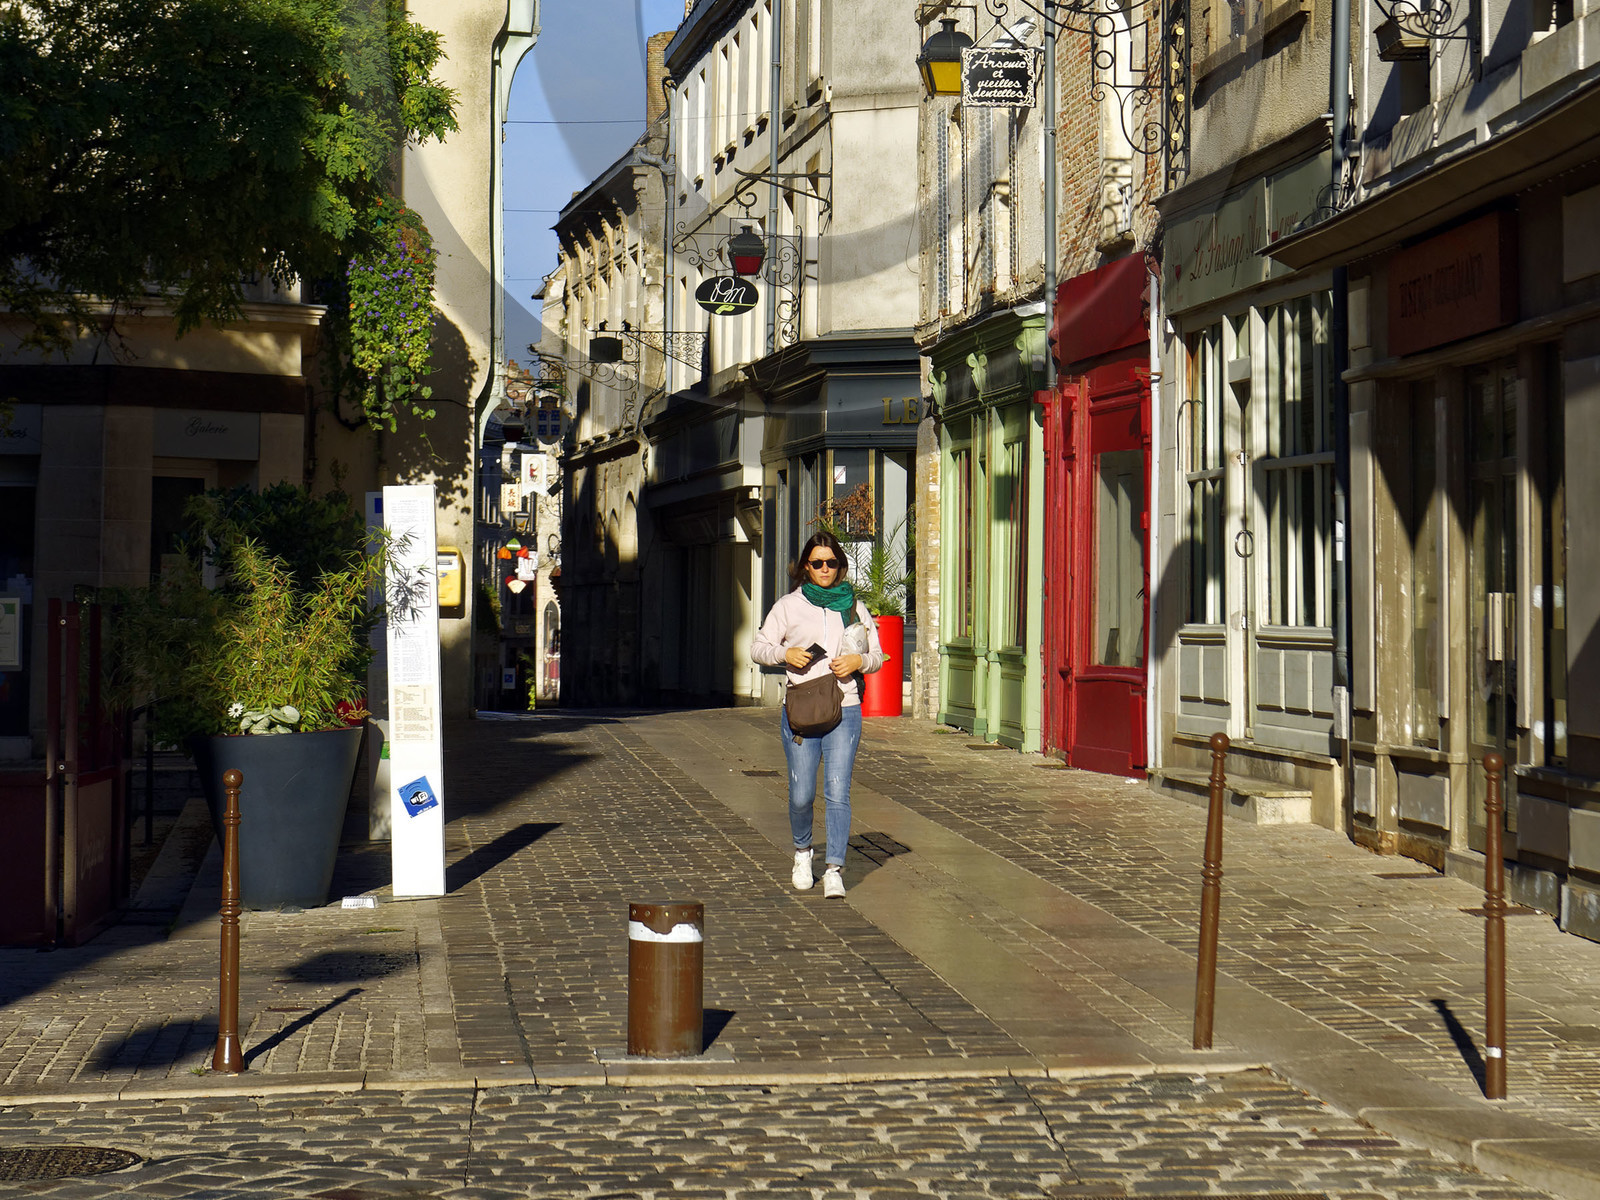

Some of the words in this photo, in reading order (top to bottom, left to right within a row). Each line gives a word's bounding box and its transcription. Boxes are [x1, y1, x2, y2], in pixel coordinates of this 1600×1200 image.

[971, 54, 1027, 69] Arsenic
[992, 68, 1004, 79] et
[977, 78, 1022, 88] vieilles
[973, 88, 1025, 98] dentelles
